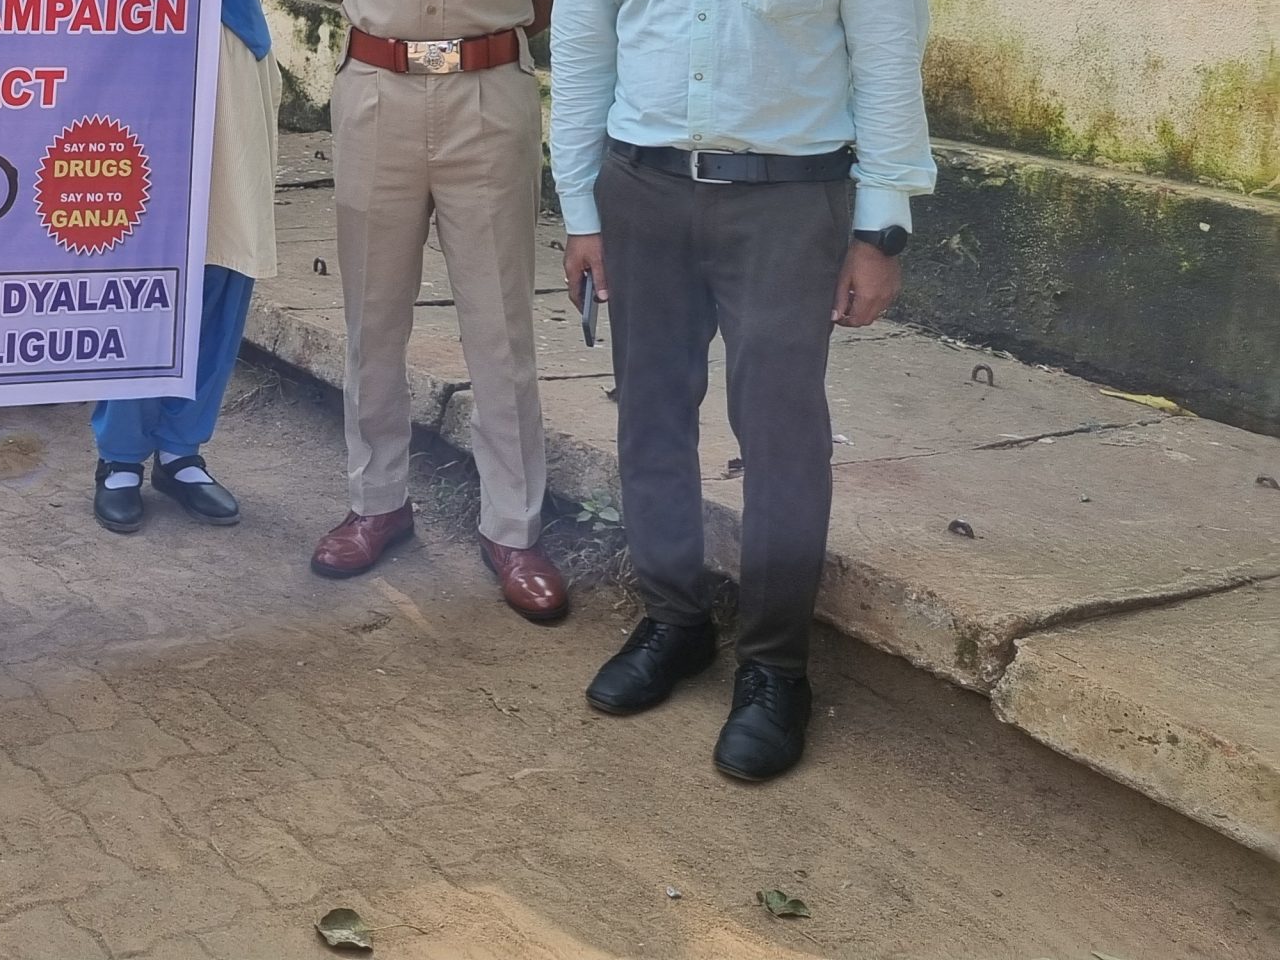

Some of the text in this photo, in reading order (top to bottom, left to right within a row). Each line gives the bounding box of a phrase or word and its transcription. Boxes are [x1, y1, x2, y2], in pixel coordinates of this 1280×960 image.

[63, 142, 125, 153] SAY NO TO
[53, 159, 133, 178] DRUGS
[60, 192, 122, 203] SAY NO TO
[51, 209, 129, 228] GANJA
